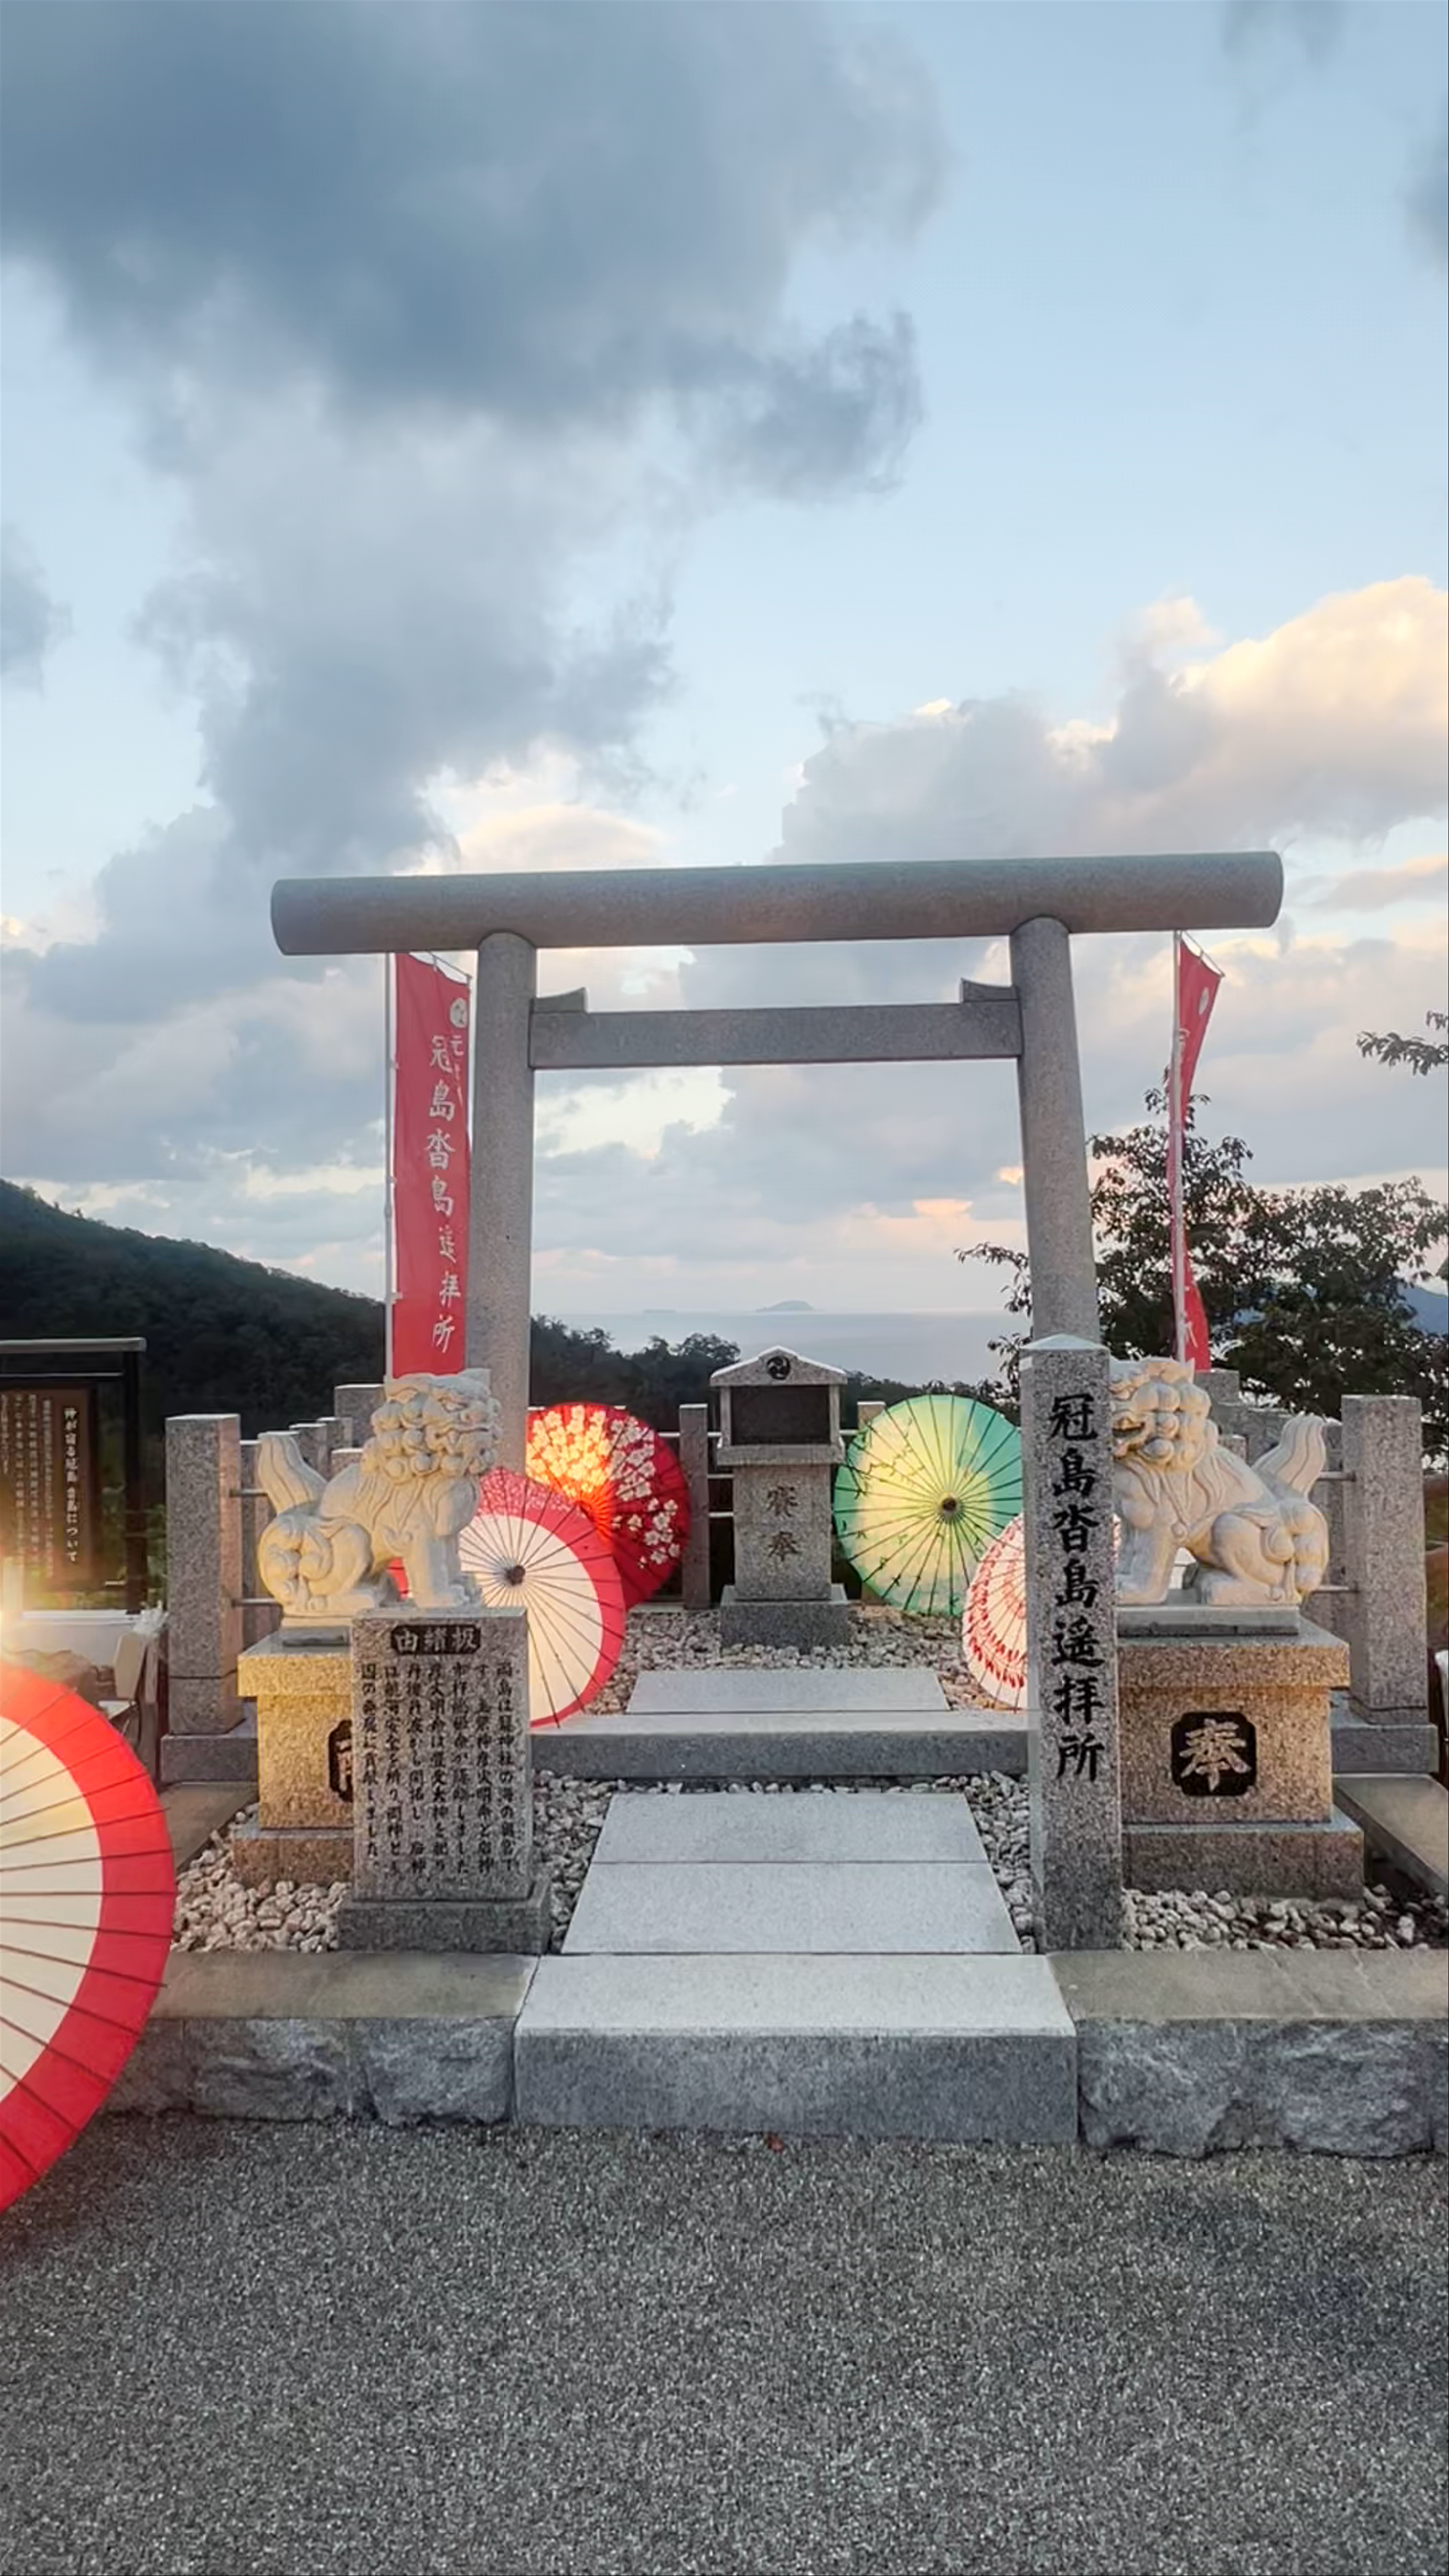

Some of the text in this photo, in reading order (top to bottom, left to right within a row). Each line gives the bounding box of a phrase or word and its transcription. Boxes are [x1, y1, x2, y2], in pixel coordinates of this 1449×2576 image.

[1047, 1393, 1105, 1782] 冠島沓島遥拝所
[1179, 1718, 1251, 1792] 奉
